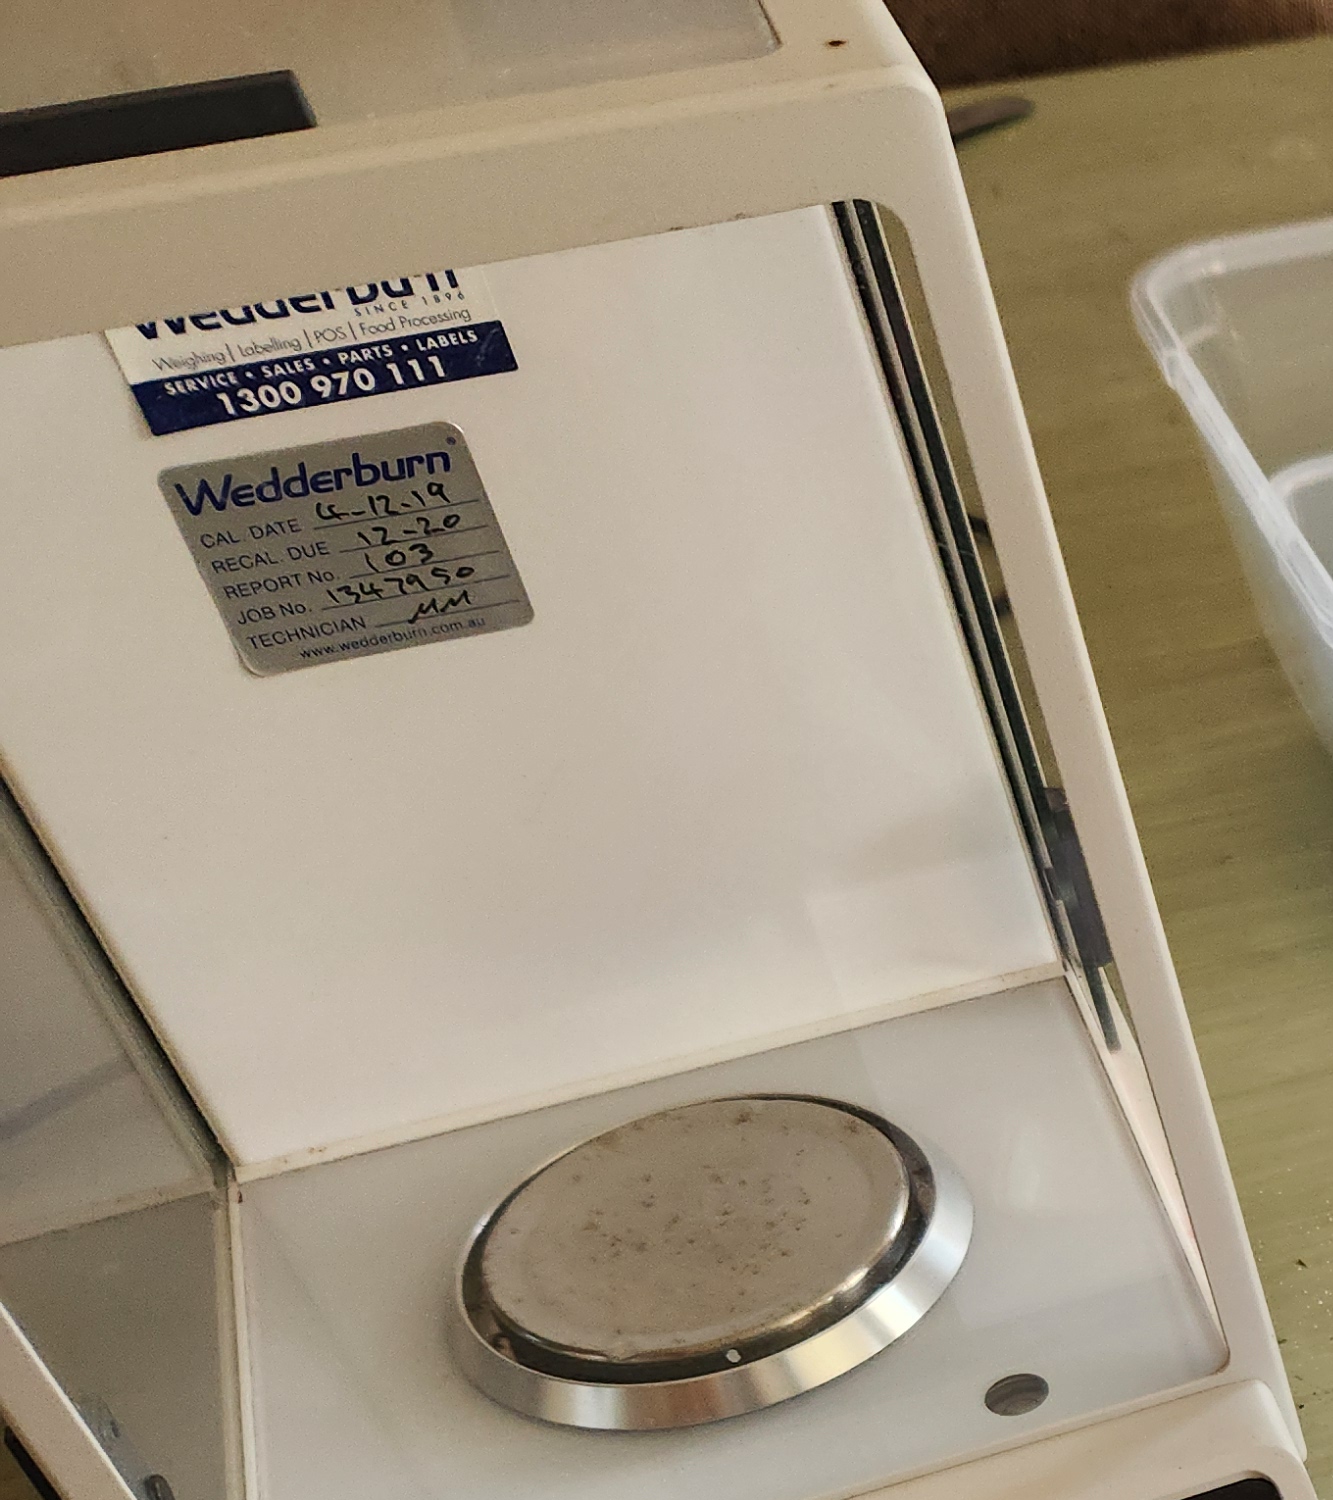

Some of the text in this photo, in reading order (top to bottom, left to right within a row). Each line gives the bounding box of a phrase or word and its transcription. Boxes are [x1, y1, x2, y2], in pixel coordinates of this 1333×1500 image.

[354, 290, 466, 317] SINCE 1896
[313, 326, 347, 344] POS
[360, 317, 397, 336] Food
[399, 307, 473, 331] Processing
[163, 328, 479, 397] SERVICE SALES PARTS LABELS
[216, 354, 448, 417] 1300 970 111
[174, 451, 451, 517] Wedderburn
[250, 518, 303, 540] DATE
[286, 541, 331, 561] DUE
[364, 543, 434, 573] 103
[223, 571, 341, 600] REPORT No.
[237, 602, 313, 626] JOB No.
[246, 616, 367, 650] TECHNICIAN
